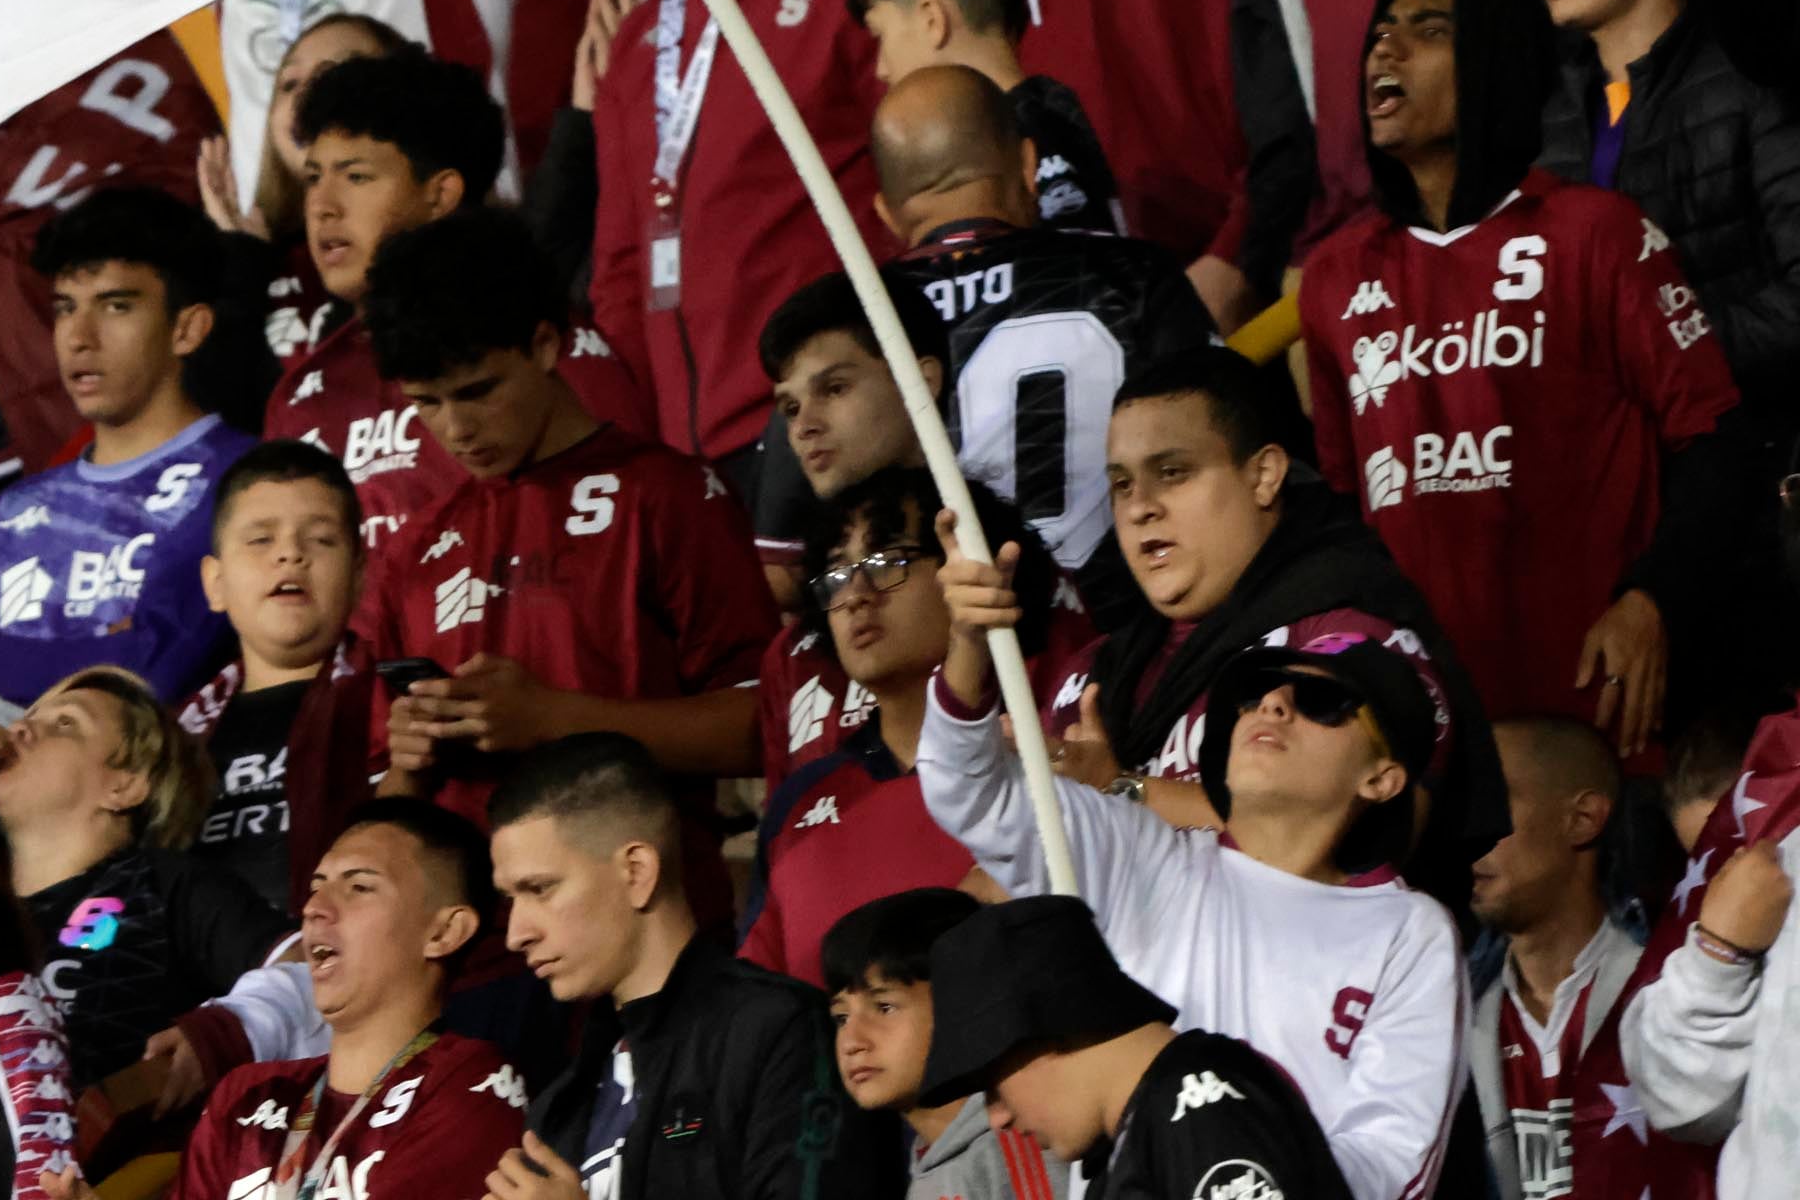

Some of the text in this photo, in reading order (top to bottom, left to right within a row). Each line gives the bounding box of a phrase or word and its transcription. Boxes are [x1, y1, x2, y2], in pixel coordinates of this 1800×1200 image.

[1492, 234, 1548, 301] S
[1400, 308, 1548, 382] kölbi
[342, 404, 422, 471] BAC
[1413, 424, 1514, 481] BAC
[144, 462, 204, 513] S
[564, 473, 621, 536] S
[368, 1074, 425, 1130] S
